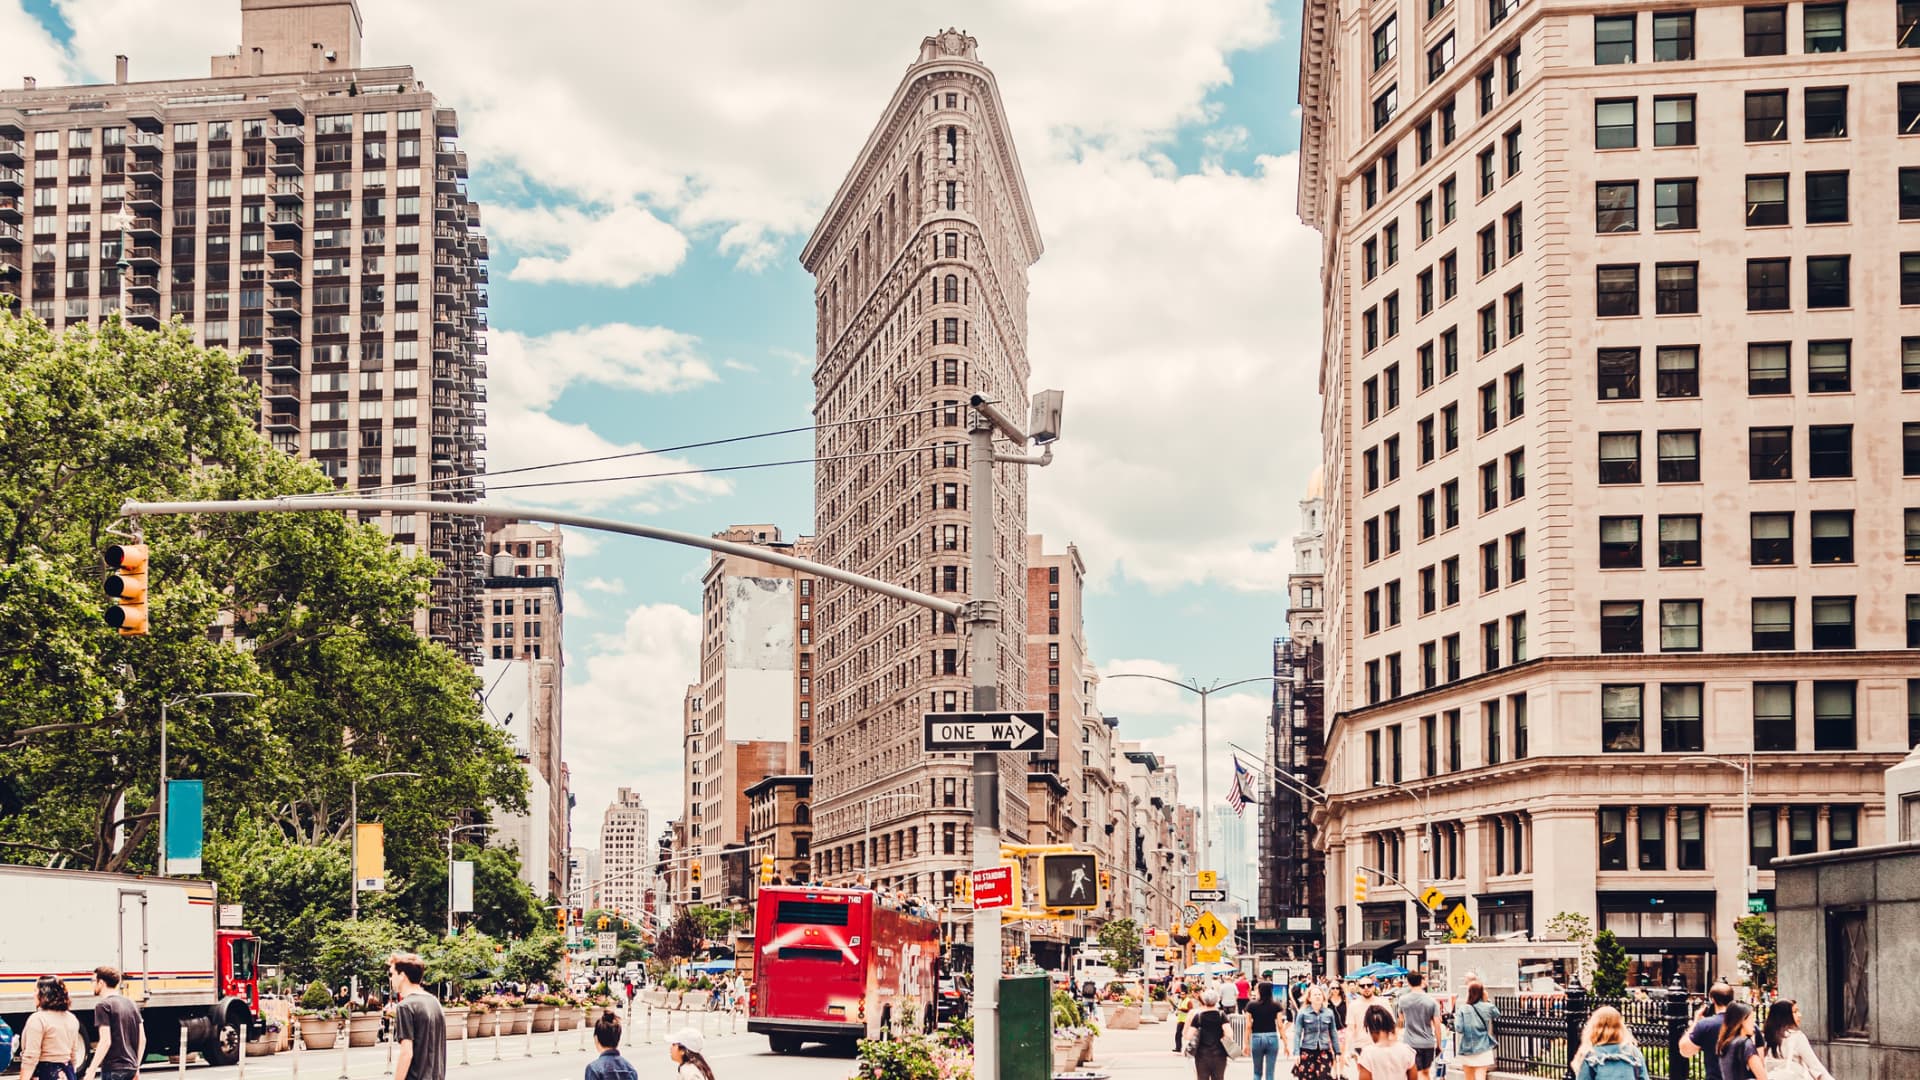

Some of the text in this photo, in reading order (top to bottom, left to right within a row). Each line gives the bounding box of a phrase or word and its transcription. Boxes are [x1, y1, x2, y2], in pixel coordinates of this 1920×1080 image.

[942, 725, 1026, 740] ONE WAY
[974, 870, 1007, 882] NO STANDING
[1204, 873, 1211, 882] 5
[975, 882, 995, 892] Anytime
